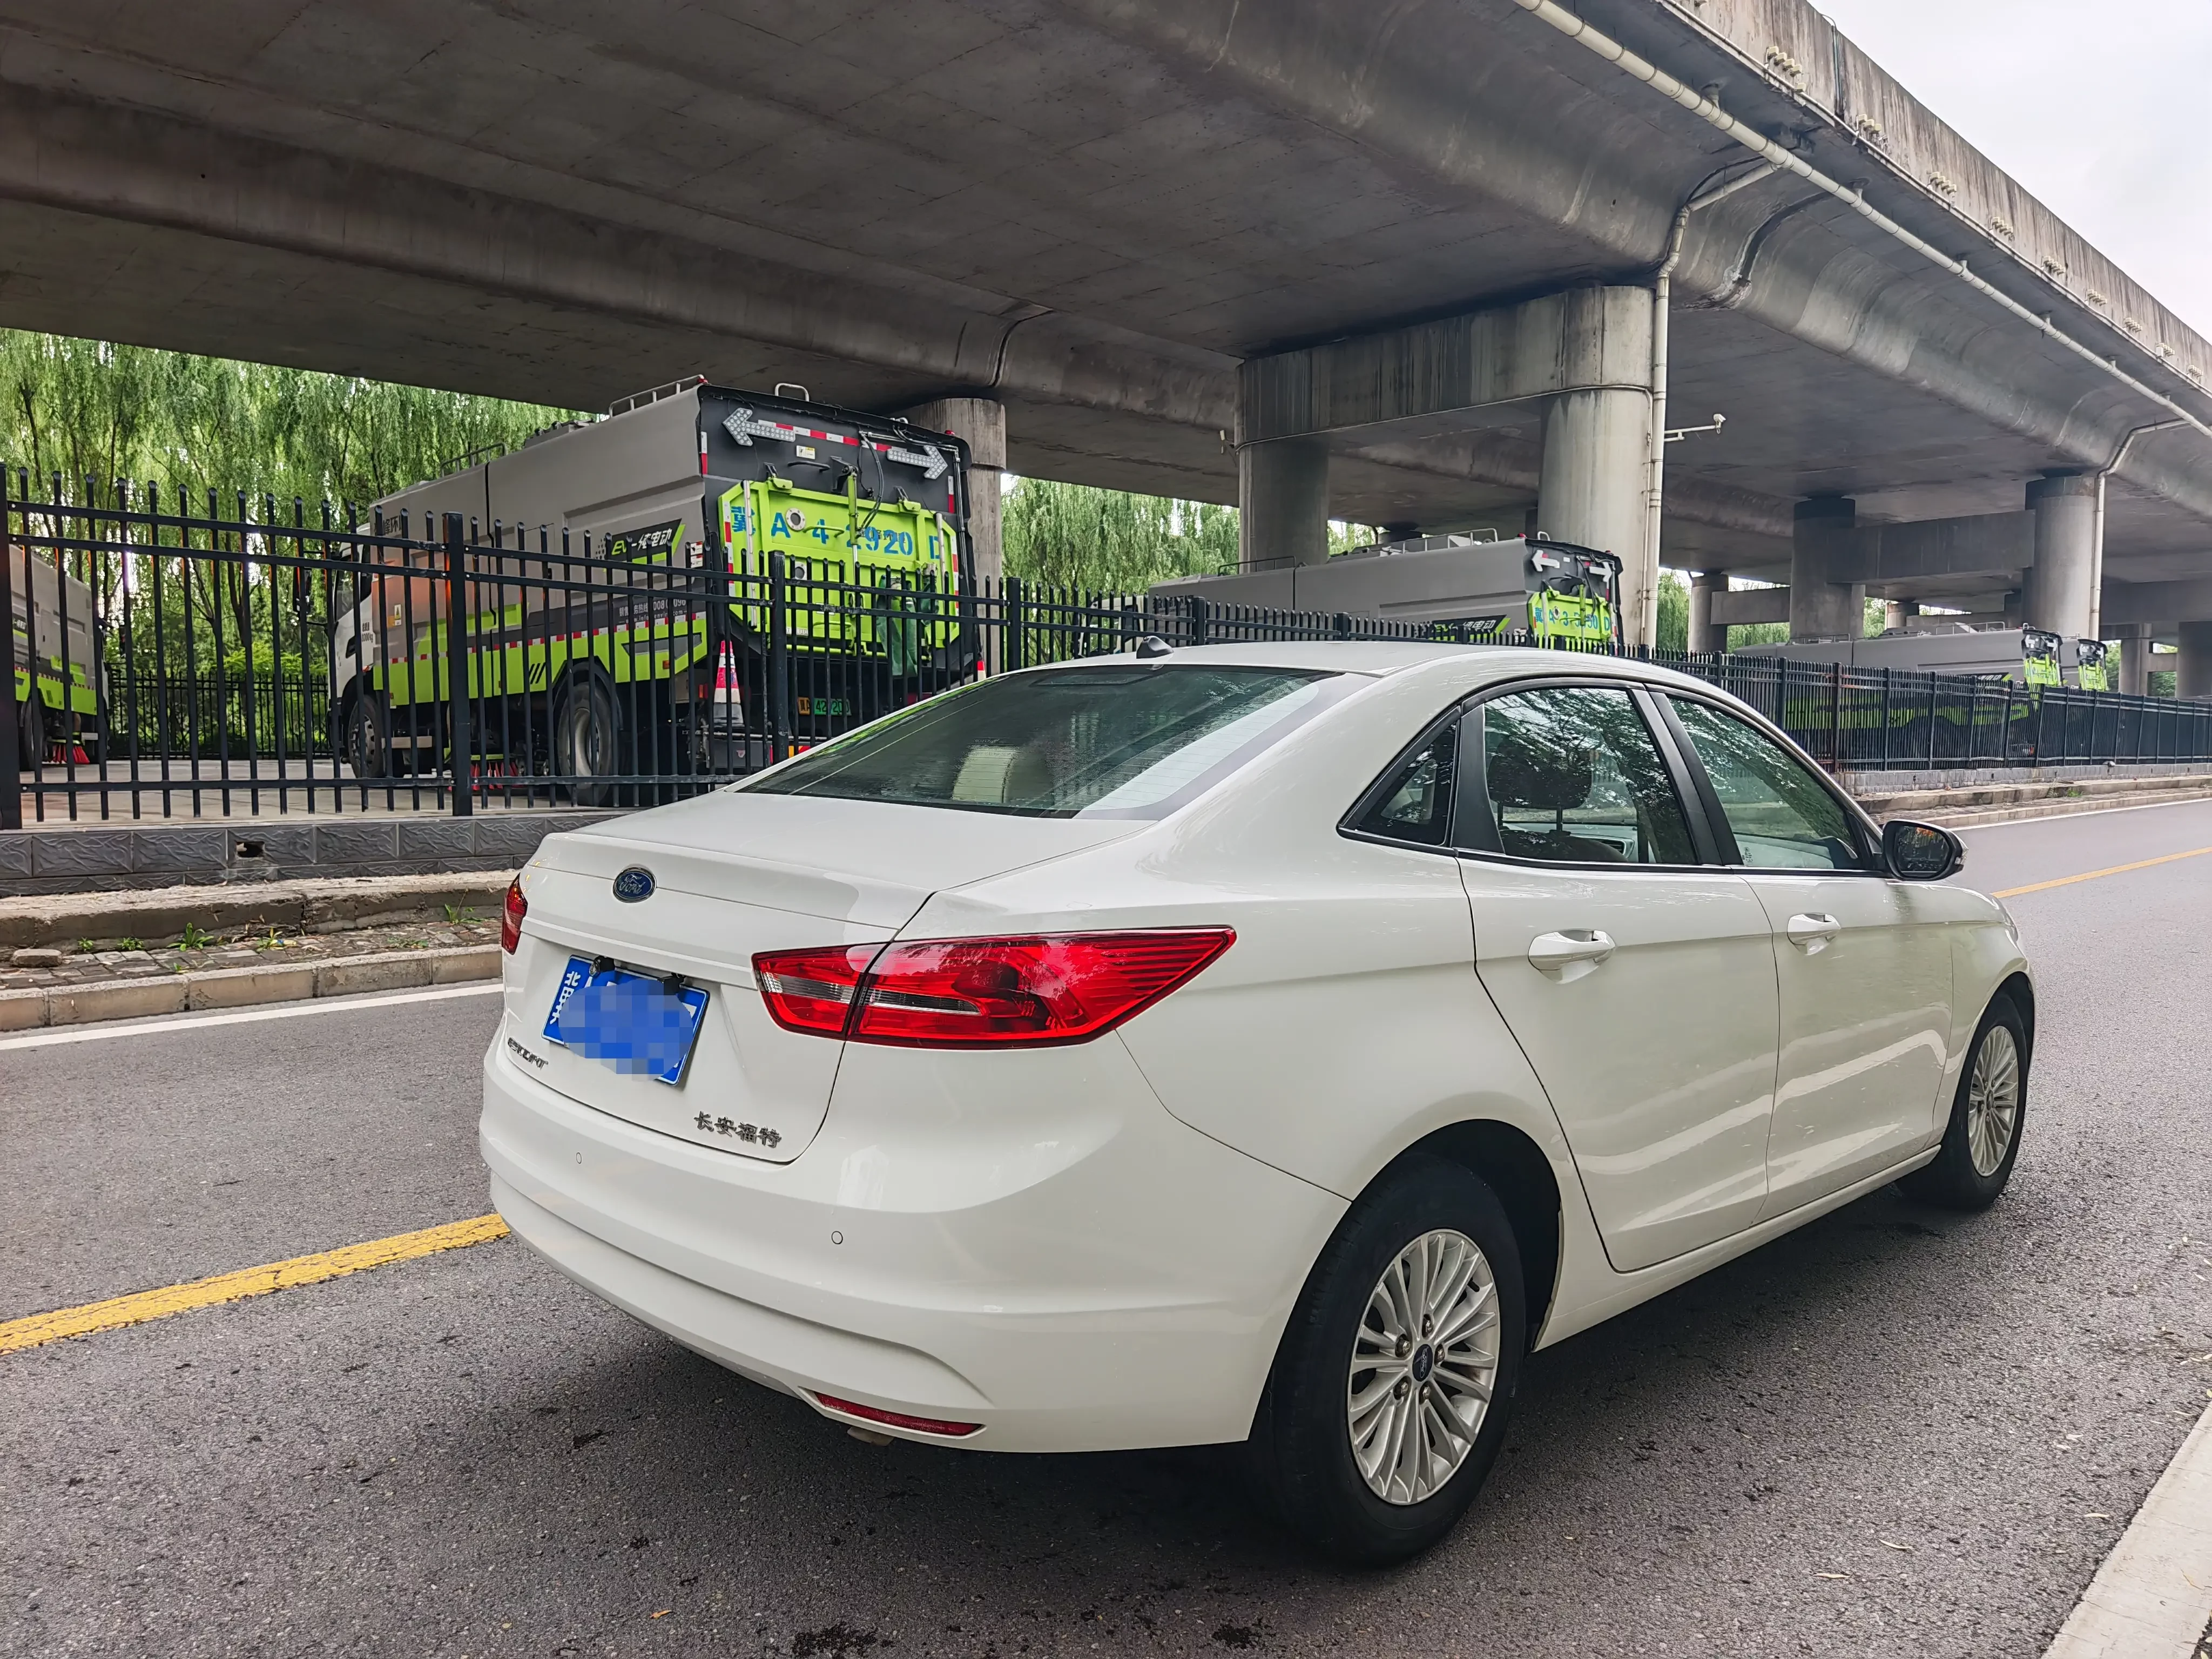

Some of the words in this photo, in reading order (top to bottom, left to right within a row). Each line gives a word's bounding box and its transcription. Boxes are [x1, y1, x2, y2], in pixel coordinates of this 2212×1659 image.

[619, 873, 646, 894] Ford
[693, 1110, 782, 1149] 长安福特
